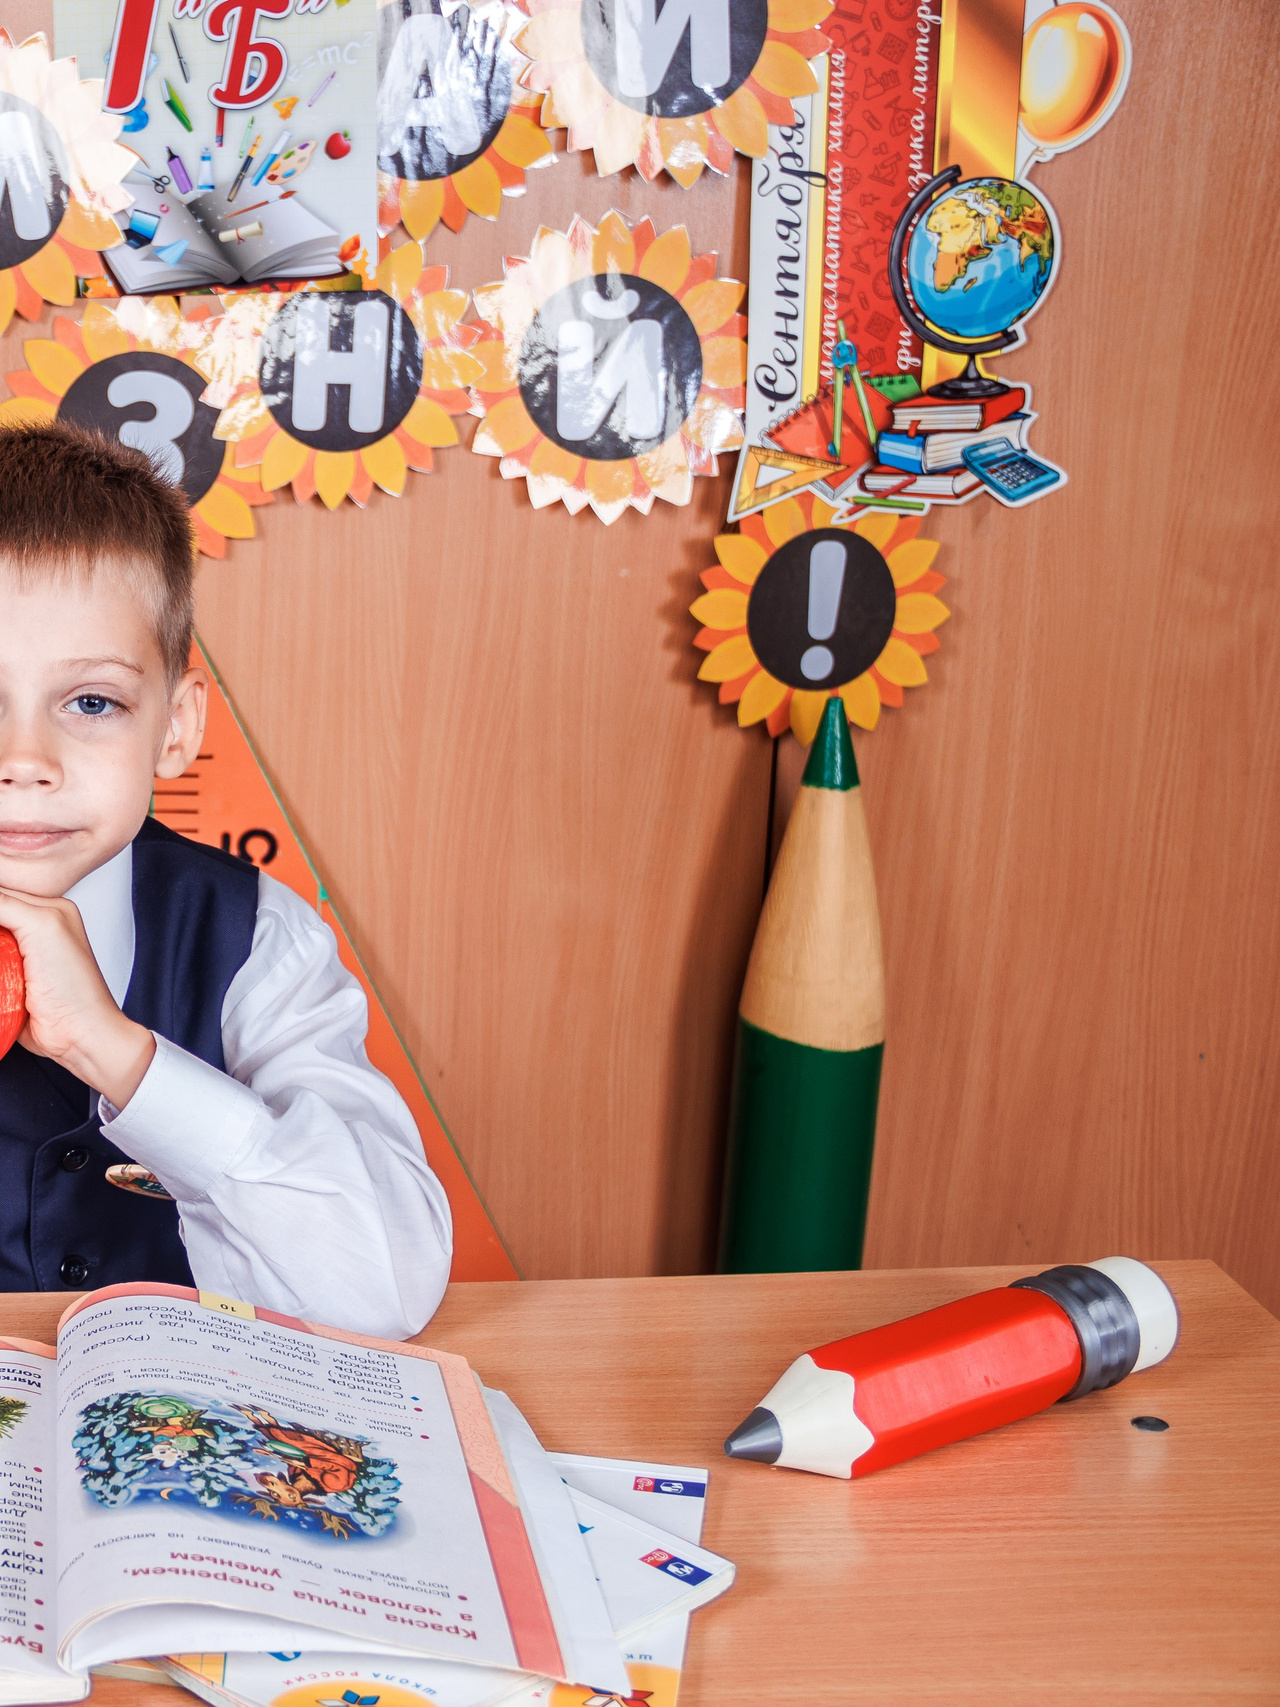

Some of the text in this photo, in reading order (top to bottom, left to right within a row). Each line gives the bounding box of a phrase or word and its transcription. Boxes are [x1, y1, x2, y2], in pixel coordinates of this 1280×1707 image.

[377, 14, 482, 156] А
[820, 48, 847, 381] математика химия
[754, 109, 828, 412] Сентября
[292, 292, 390, 433] Н
[556, 289, 664, 441] Й
[800, 539, 848, 681] !
[219, 1303, 237, 1313] 10
[83, 1320, 401, 1384] Октябрь землю покрыл где листом,
[125, 1305, 397, 1369] Ноябрь ворота зимы. (Русская
[148, 1312, 399, 1376] снежком. (Русская пословица.)
[366, 1351, 395, 1361] ца.)
[82, 1333, 404, 1399] Сентябрь да сыт. (Русская
[178, 1370, 228, 1384] встречи
[327, 1369, 402, 1391] словица.)
[93, 1373, 413, 1438] Опиши, что изображено иллюстрации. Как
[260, 1389, 329, 1413] произошло
[271, 1374, 407, 1410] Почему так говорят?
[337, 1411, 357, 1421] что
[366, 1417, 412, 1431] маешь,
[3, 1460, 27, 1469] Что
[9, 1481, 43, 1494] ным
[24, 1475, 43, 1485] ки
[11, 1490, 43, 1503] ные
[93, 1532, 451, 1599] Вспомни, какие буквы указывают мягкость
[169, 1551, 473, 1622] а человек уменьем
[366, 1569, 449, 1590] ного звука.
[123, 1567, 477, 1641] Красна птица опереньем,
[282, 1670, 437, 1696] ШКОЛА РОССИИ
